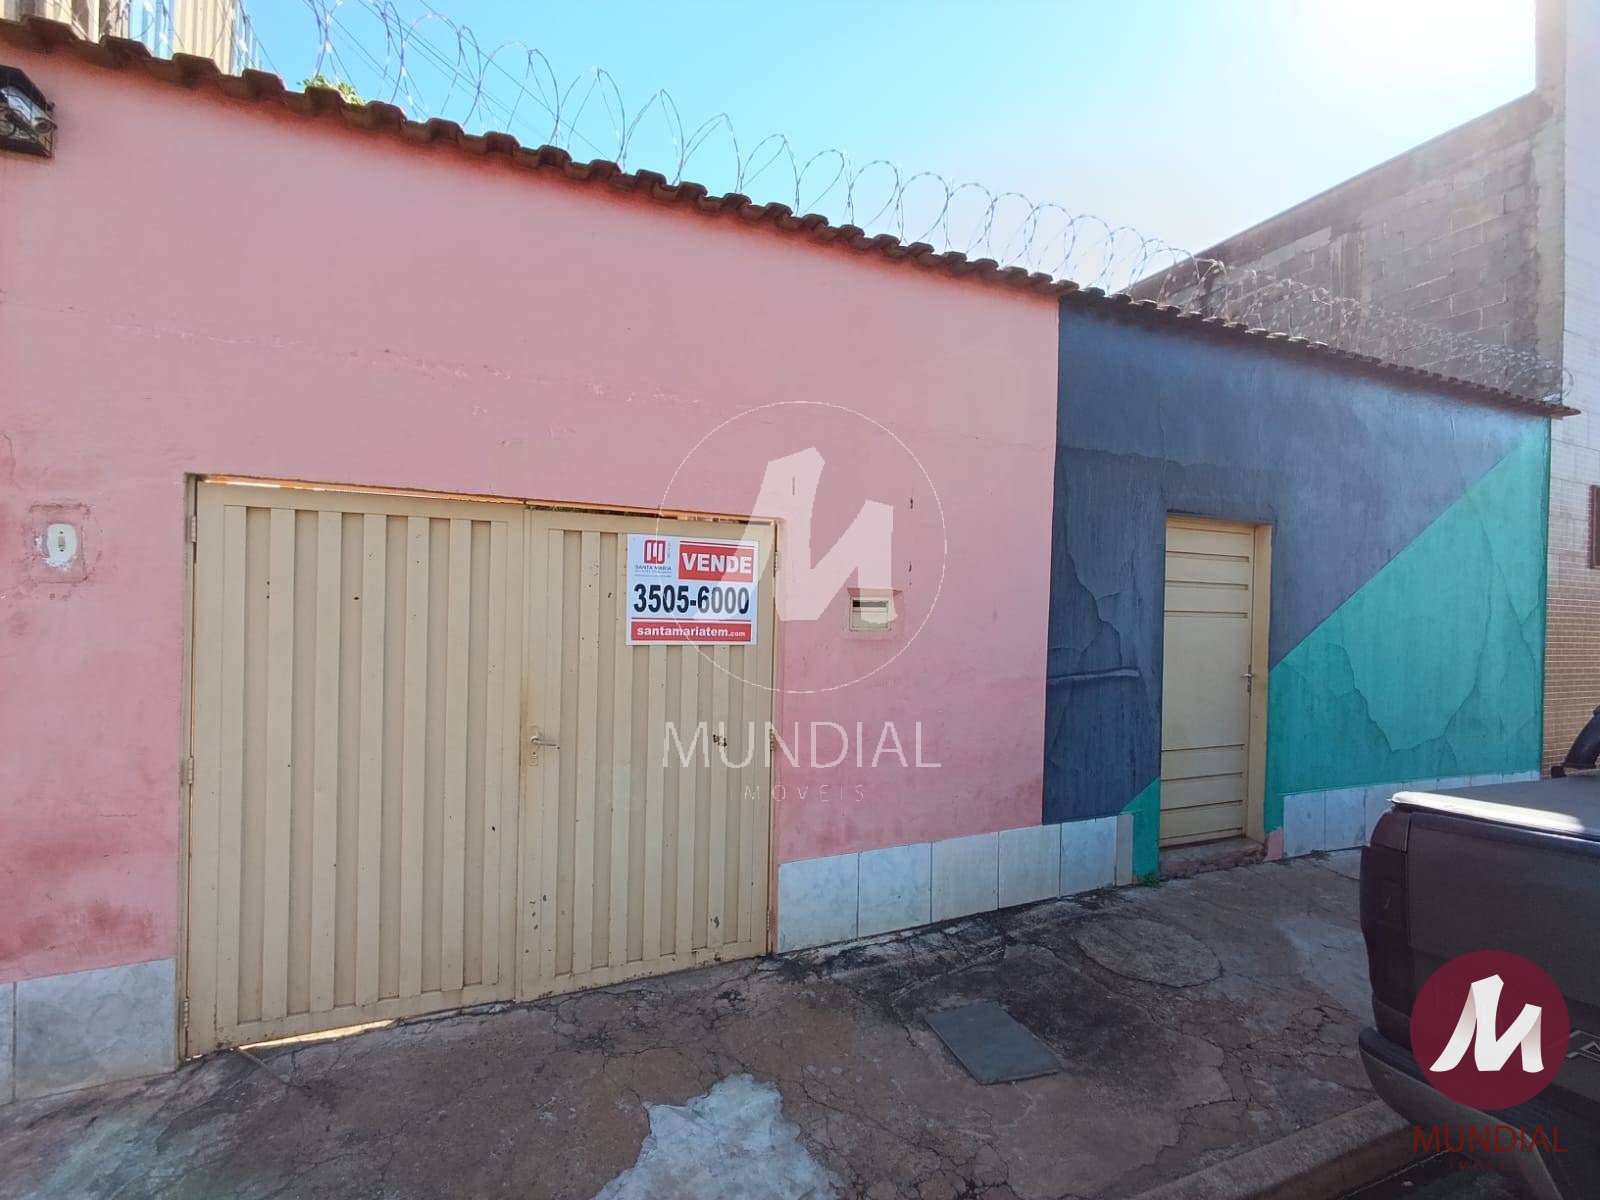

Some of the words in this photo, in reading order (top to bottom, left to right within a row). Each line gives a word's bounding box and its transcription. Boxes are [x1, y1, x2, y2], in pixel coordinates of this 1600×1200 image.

[682, 553, 752, 574] VENDE
[633, 583, 750, 614] 3505-6000
[637, 626, 746, 637] santamariatem.com
